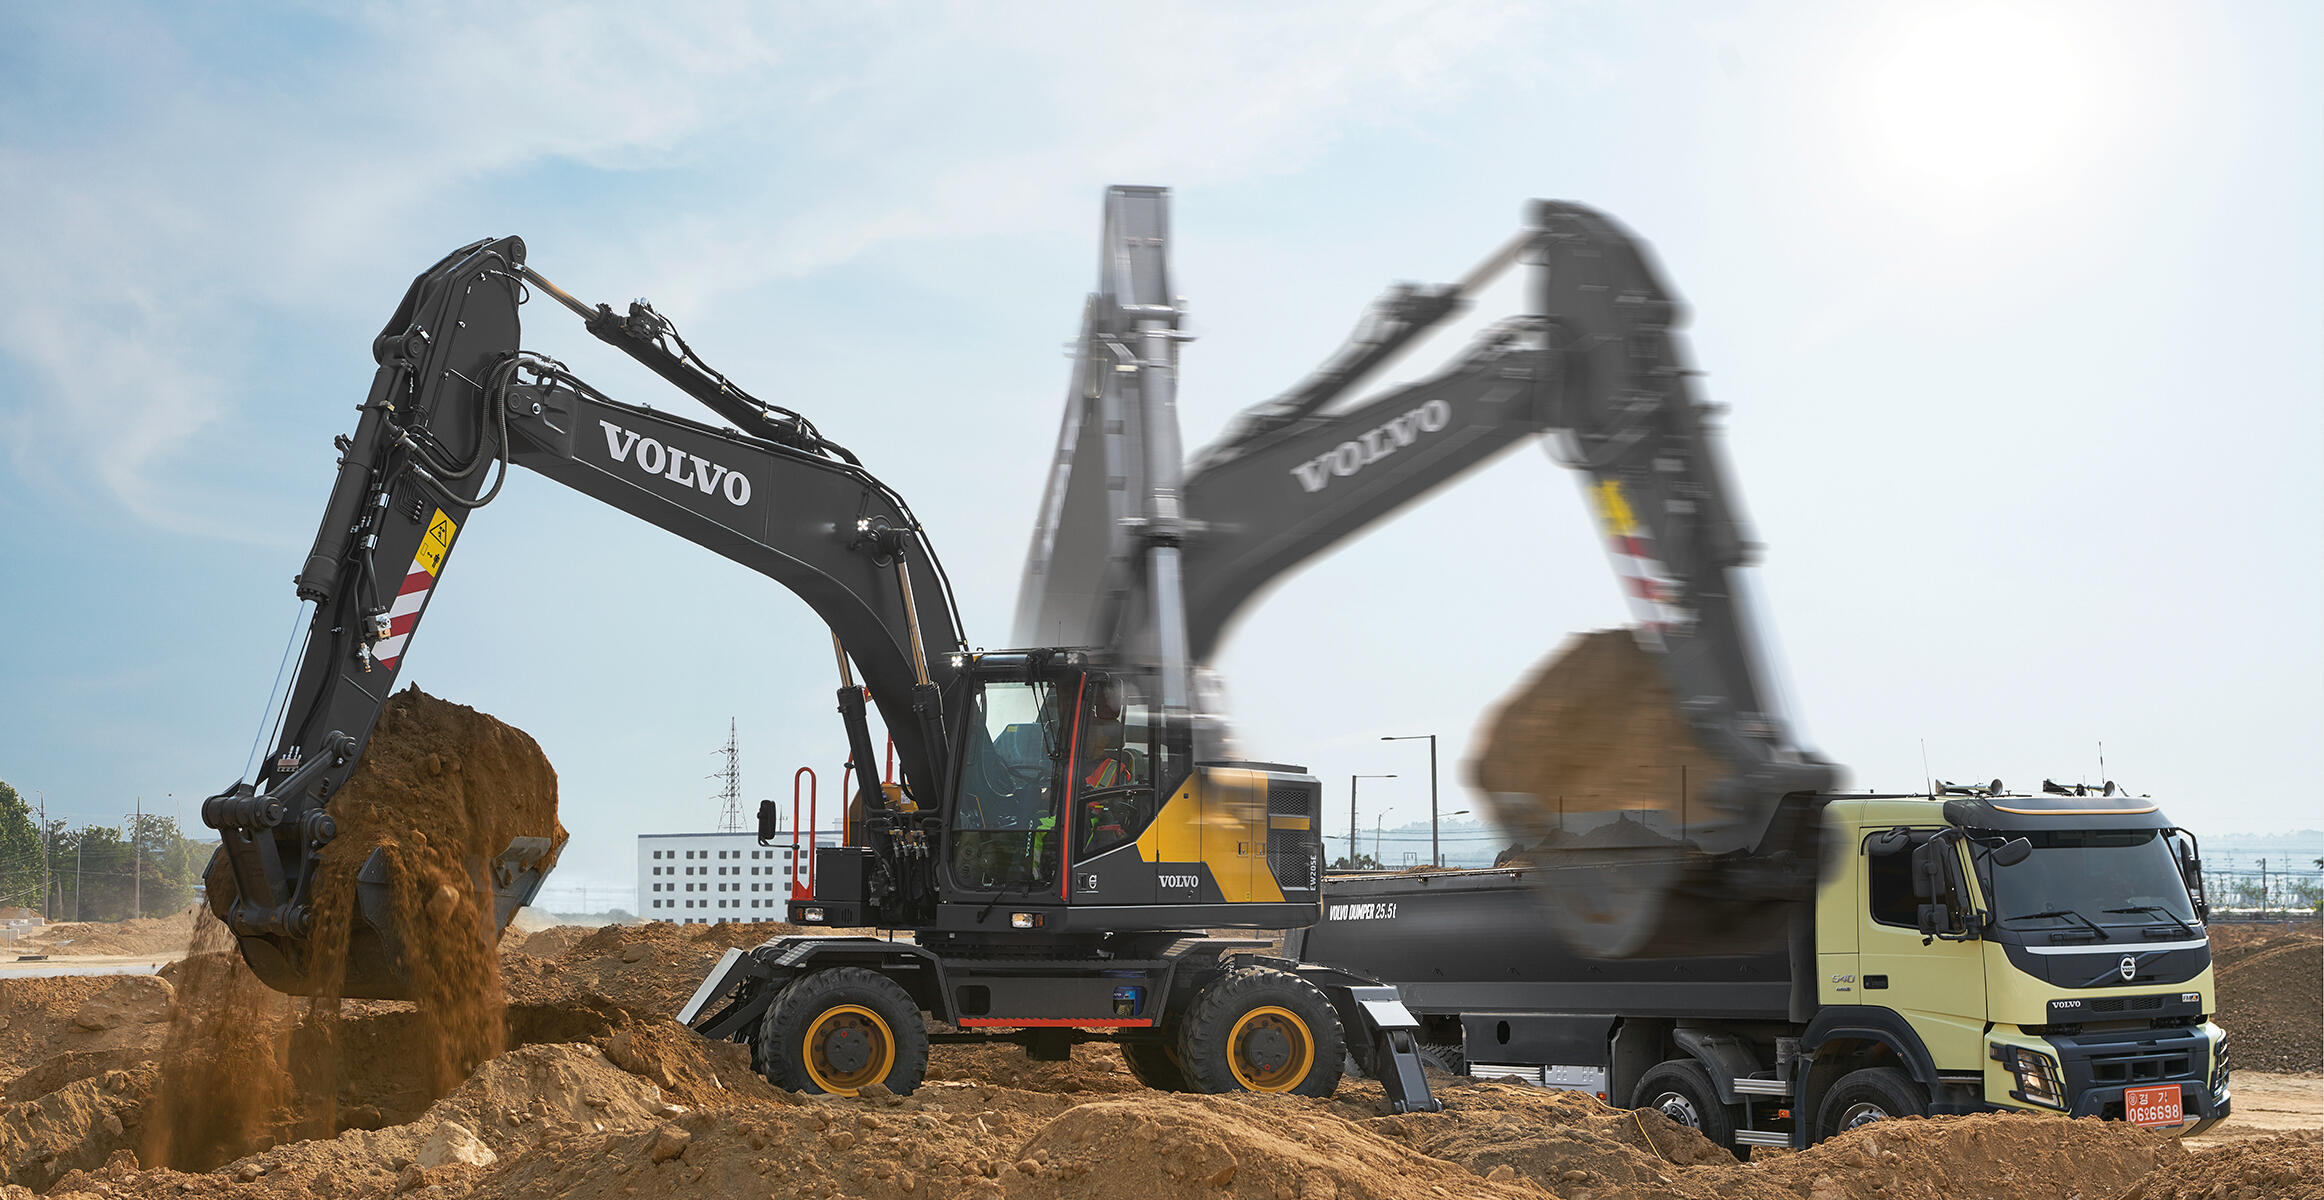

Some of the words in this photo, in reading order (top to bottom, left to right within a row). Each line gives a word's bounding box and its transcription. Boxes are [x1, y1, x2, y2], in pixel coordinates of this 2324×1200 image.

[1289, 400, 1451, 492] VOLVO
[599, 419, 751, 506] VOLVO
[1159, 875, 1199, 888] VOLVO
[1329, 904, 1348, 920] VOLVO
[1349, 903, 1375, 920] DUMPER
[1375, 903, 1397, 919] 25.5t
[1832, 974, 1855, 983] 540
[2052, 1000, 2081, 1009] VOLVO
